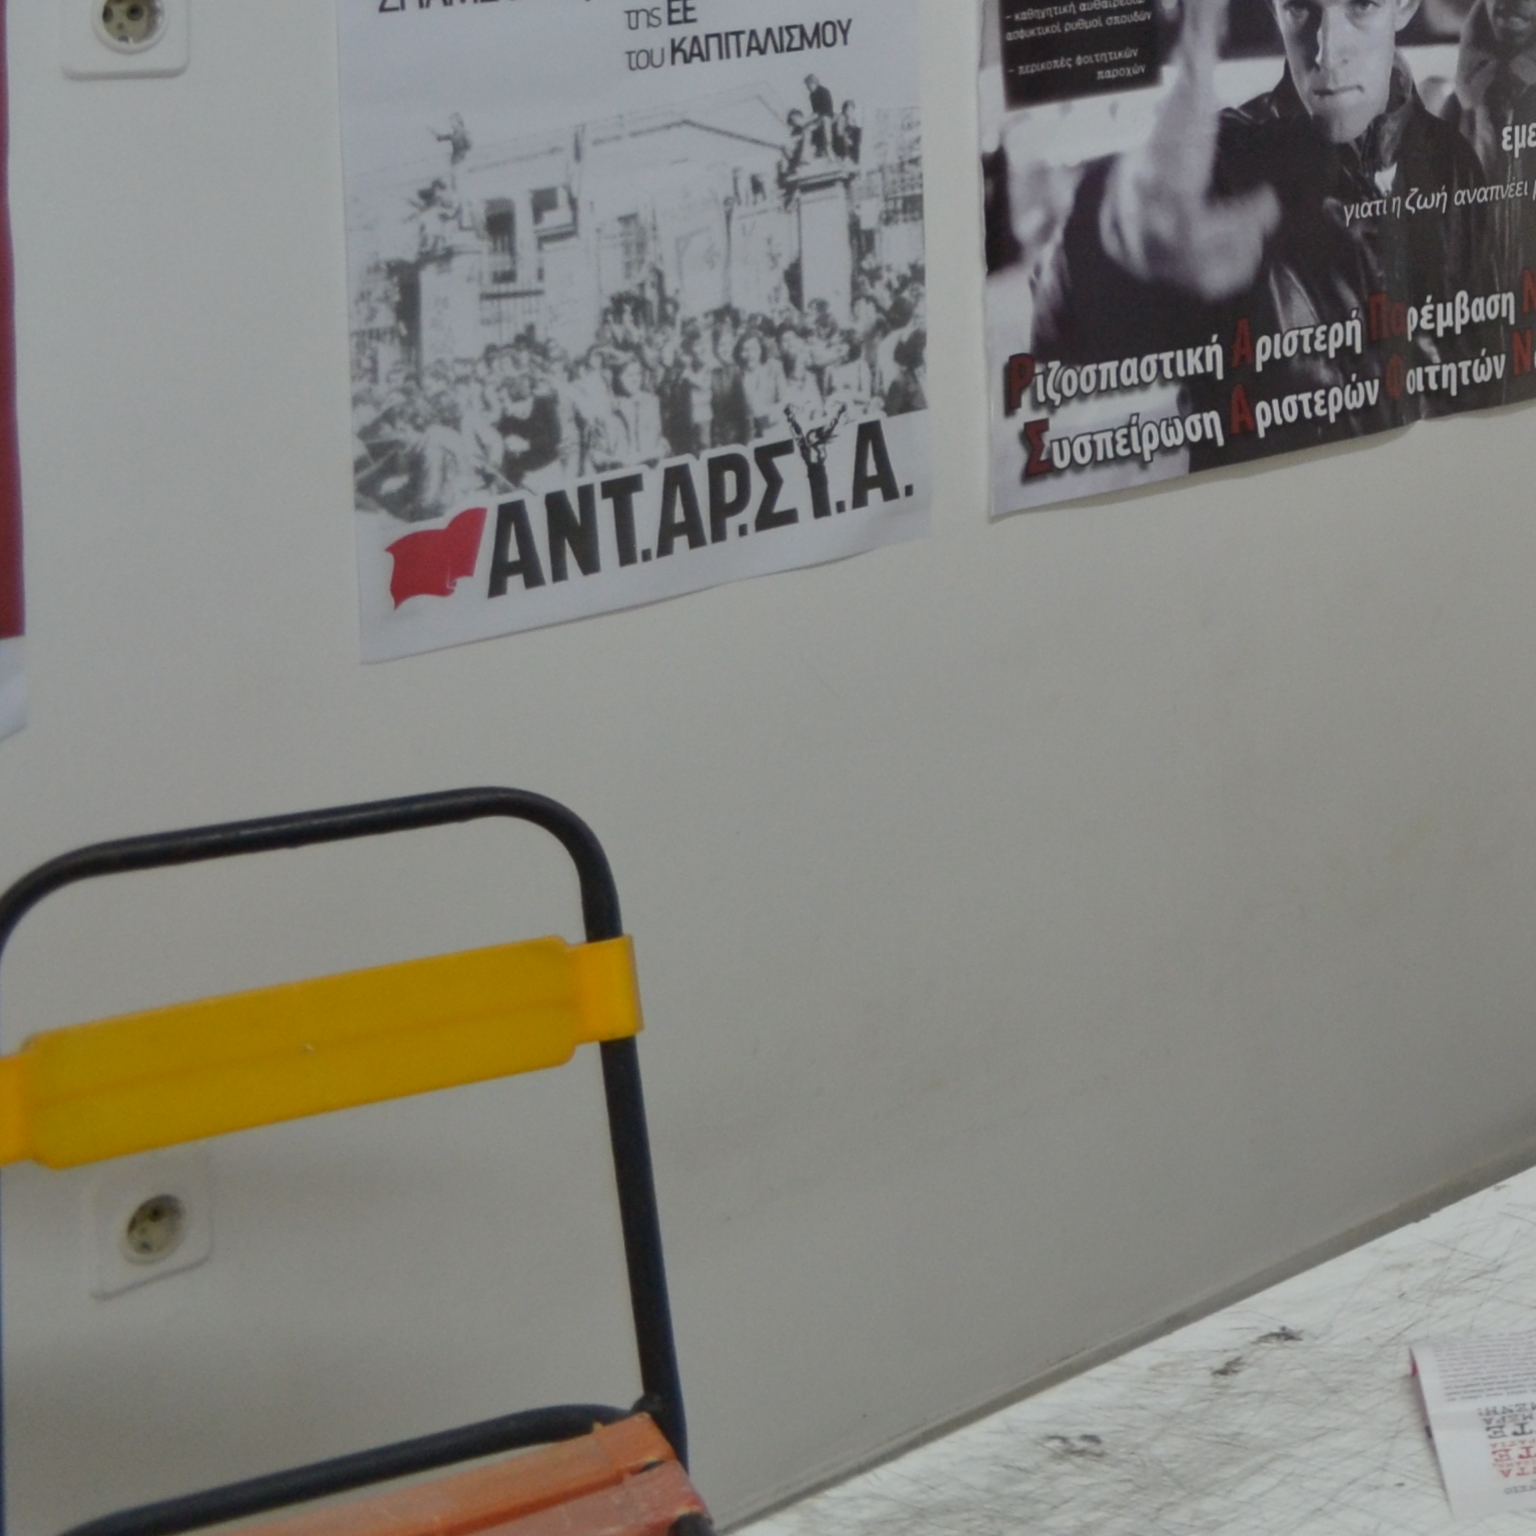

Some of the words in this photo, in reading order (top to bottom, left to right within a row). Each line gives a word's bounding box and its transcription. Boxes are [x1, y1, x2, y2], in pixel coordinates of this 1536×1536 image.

[624, 4, 663, 31] της
[624, 44, 665, 70] του
[669, 19, 853, 66] ΚΑΠΙΤΑΛΙΣΜΟΥ
[1343, 194, 1388, 227] γιατί
[1391, 196, 1401, 218] η
[1404, 186, 1448, 219] ζωή
[1454, 178, 1528, 207] αναπνέει
[1005, 333, 1225, 415] Ριζοσπαστική
[1232, 309, 1363, 373] Αριστερή
[1368, 288, 1516, 342] Παρέμβαση
[1022, 410, 1226, 481] Συσπείρωση
[1230, 373, 1381, 438] Αριστερών
[1386, 348, 1506, 400] Φοιτητών
